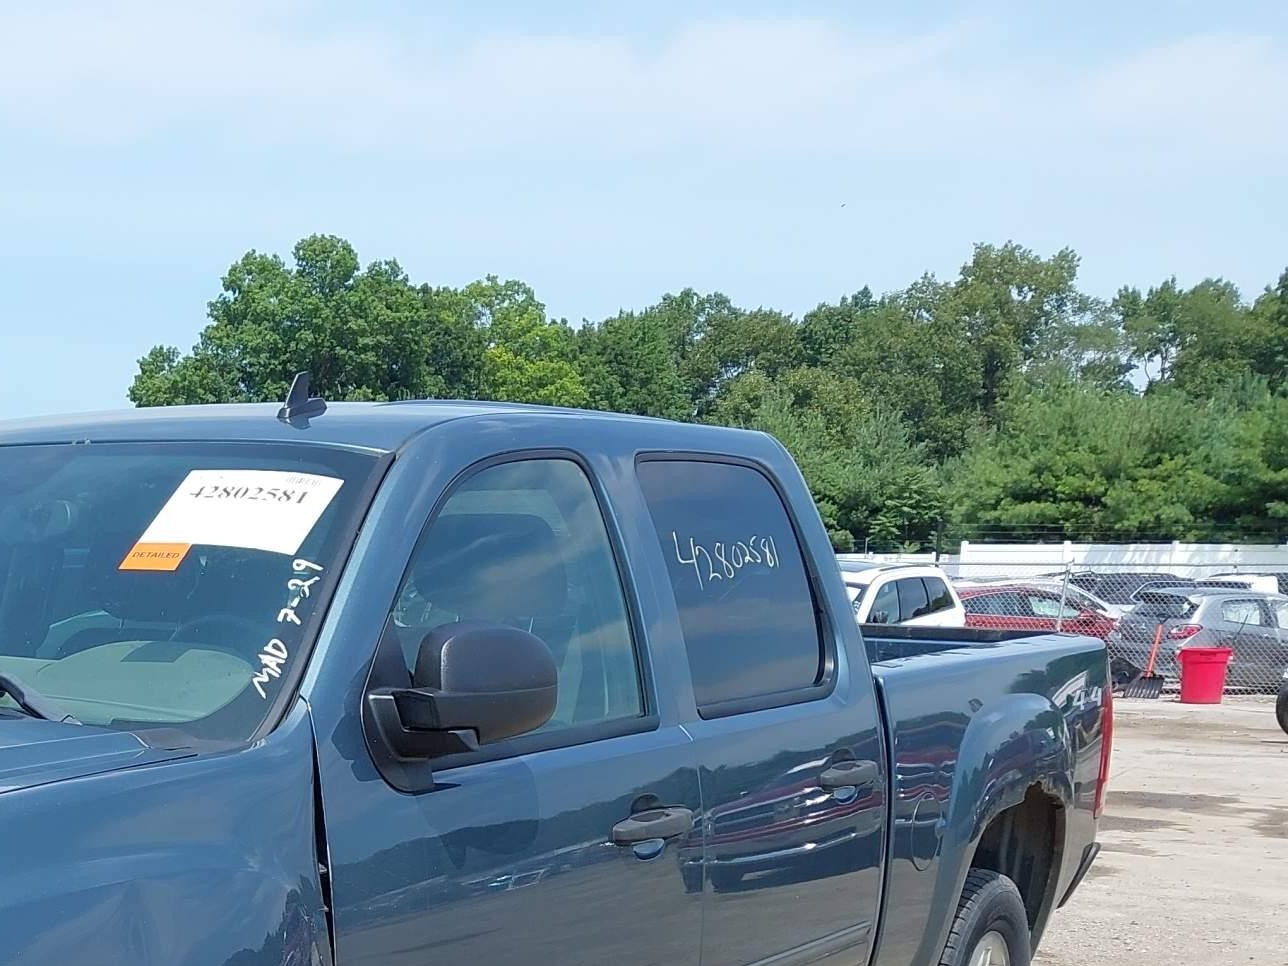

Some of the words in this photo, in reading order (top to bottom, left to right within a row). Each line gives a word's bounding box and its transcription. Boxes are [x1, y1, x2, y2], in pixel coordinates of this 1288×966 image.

[190, 486, 309, 504] 42802581
[132, 551, 180, 559] DETAILED
[672, 530, 779, 591] 42802581
[277, 558, 324, 625] 7-29
